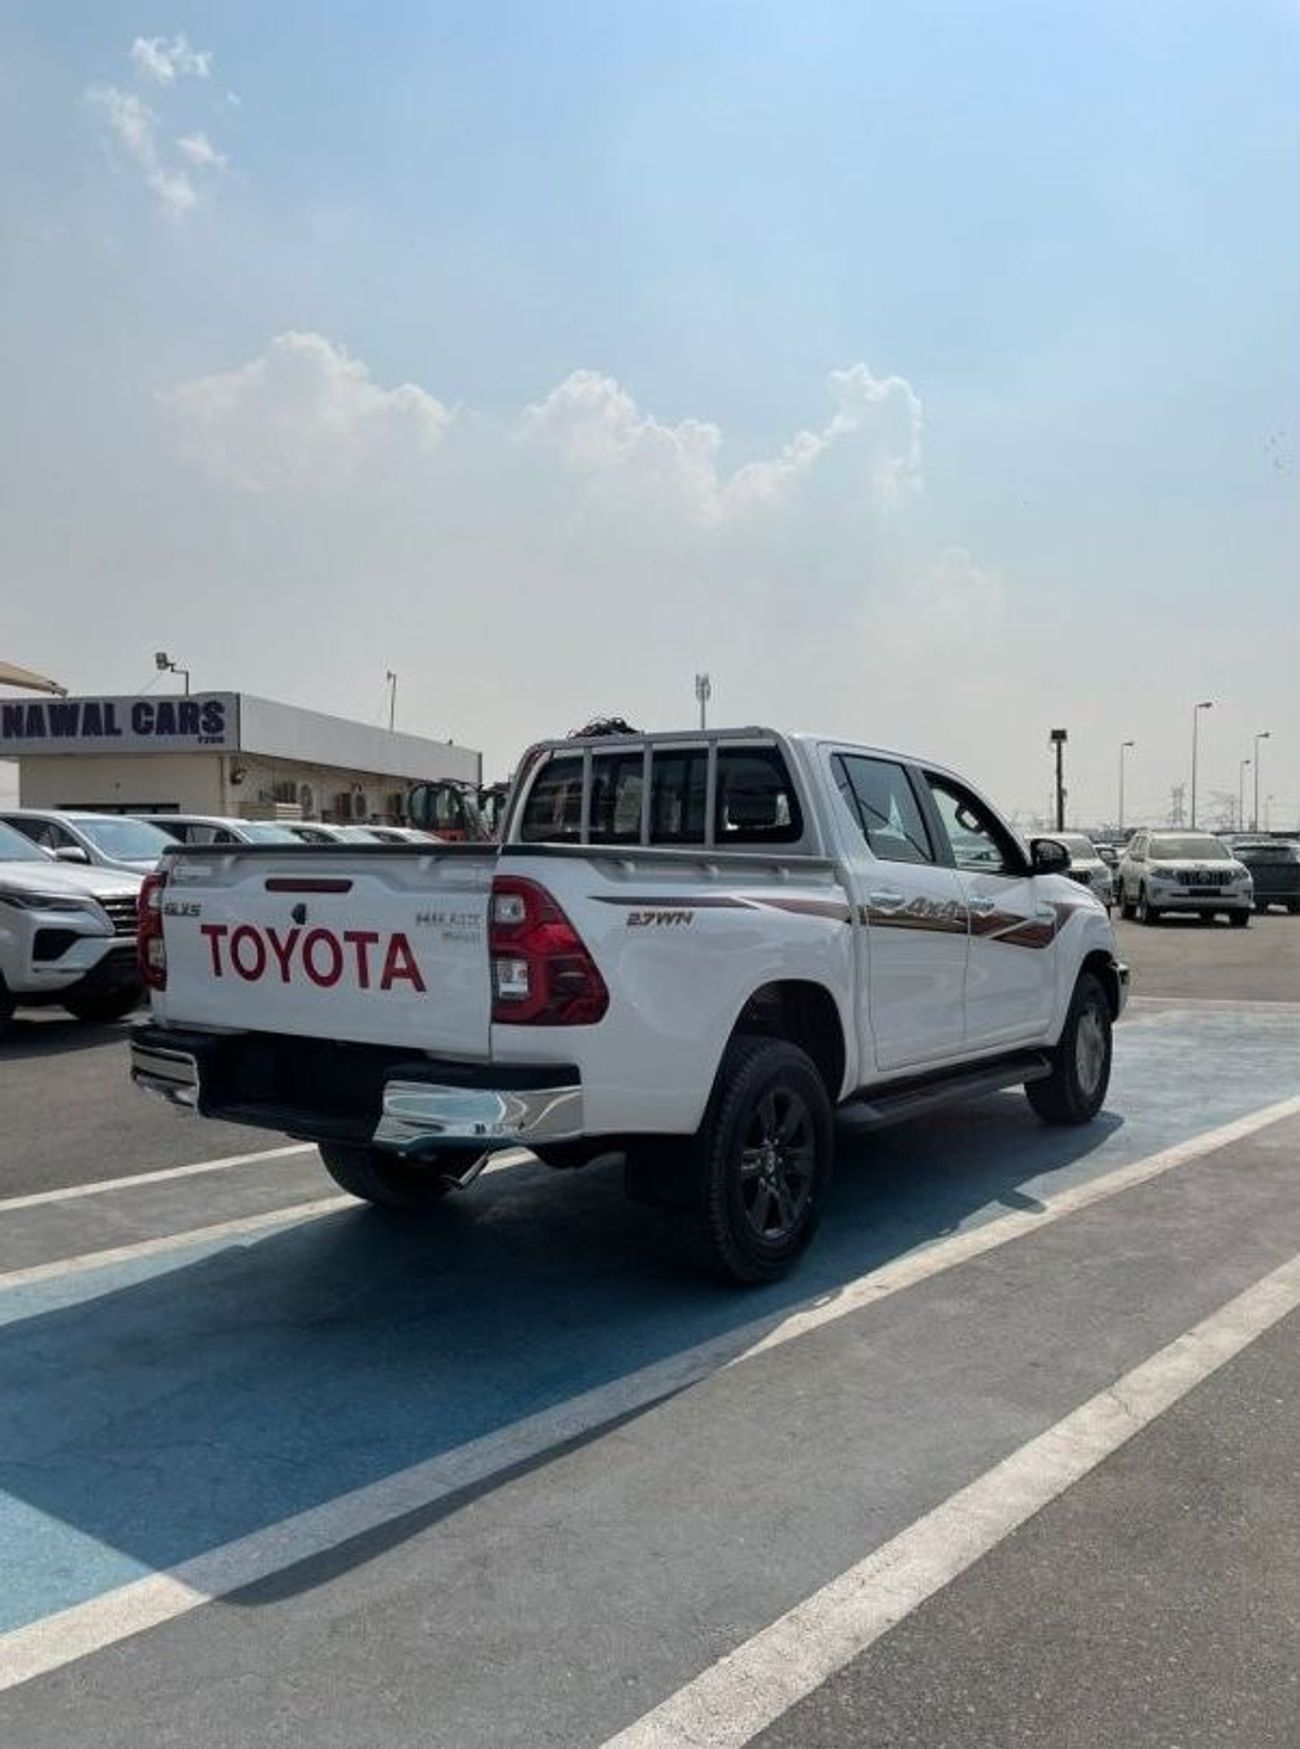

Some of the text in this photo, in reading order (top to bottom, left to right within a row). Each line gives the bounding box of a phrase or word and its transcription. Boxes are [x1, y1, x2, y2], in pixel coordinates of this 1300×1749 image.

[2, 701, 226, 738] NAWAL CARS
[200, 924, 427, 993] TOYOTA
